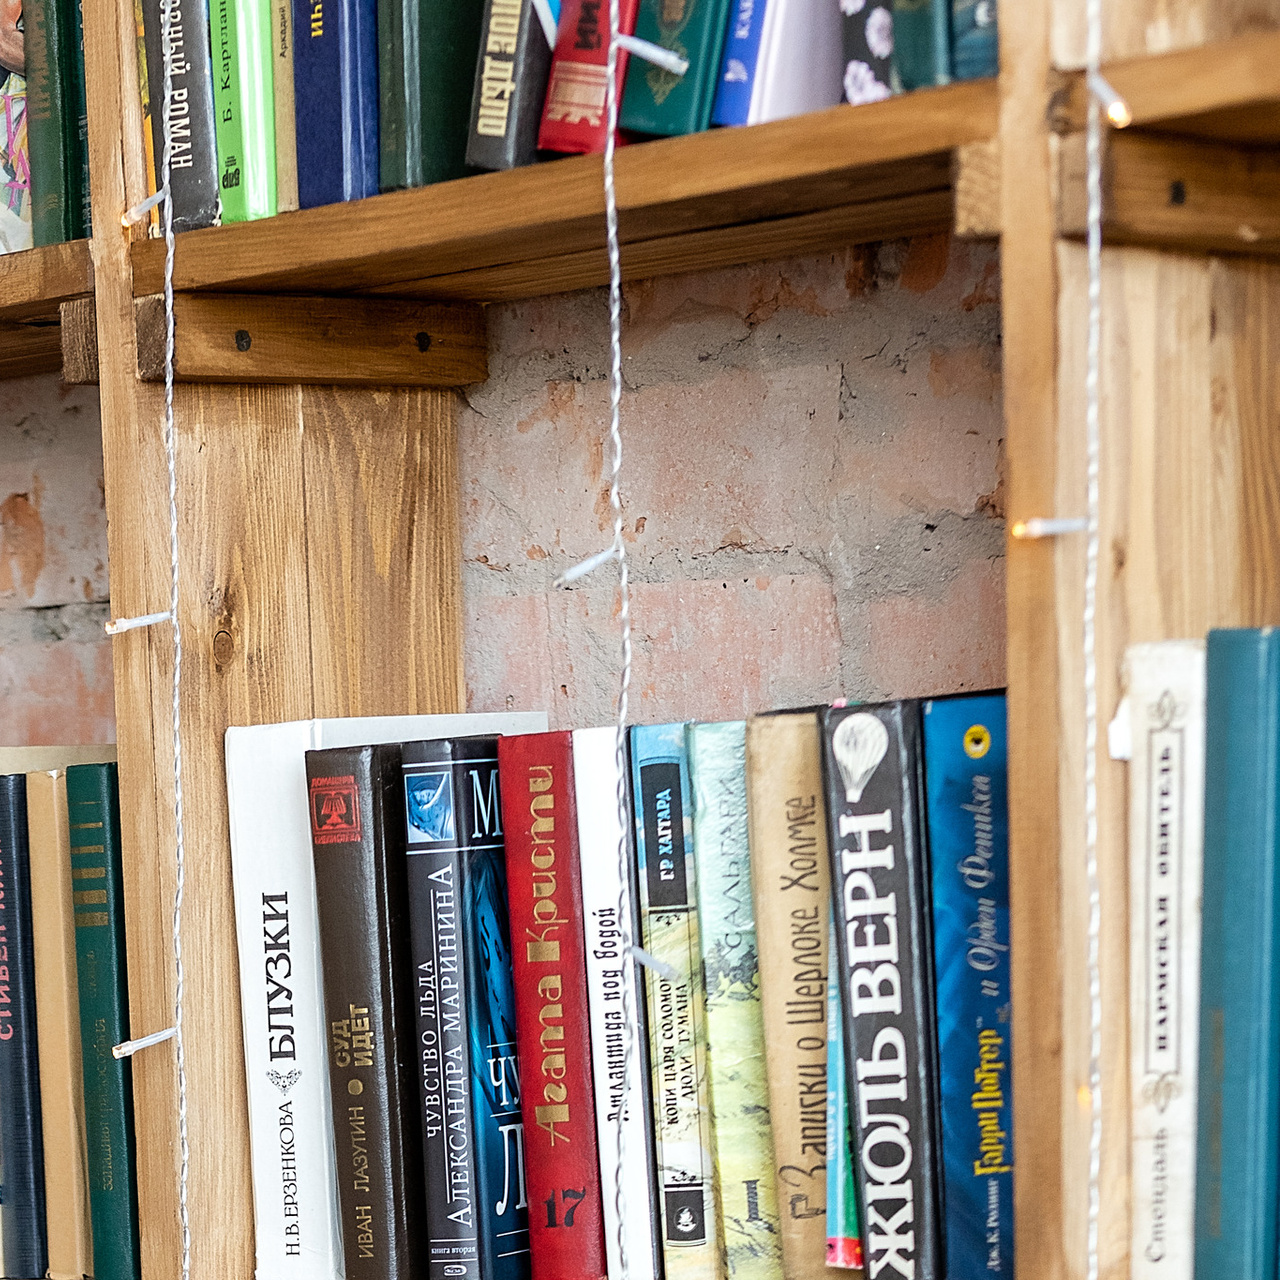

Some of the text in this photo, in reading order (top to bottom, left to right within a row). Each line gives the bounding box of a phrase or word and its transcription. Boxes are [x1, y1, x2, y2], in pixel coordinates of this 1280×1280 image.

[279, 6, 287, 58] Аркадий
[169, 87, 193, 169] РОМАН
[223, 102, 232, 123] Б.
[654, 788, 673, 858] ХАГГАРД
[716, 775, 742, 952] САЛЬГАРИ
[958, 775, 1008, 998] и Орден Феникса
[261, 891, 298, 1061] БЛУЗКИ
[524, 764, 572, 1147] Агата Кристи
[839, 809, 903, 1018] ВЕРН
[1155, 896, 1169, 1054] ПАРМСКАЯ
[331, 1020, 351, 1068] СУД
[349, 1004, 372, 1067] ИДЕТ
[417, 959, 441, 1138] ЧУВСТВО ЛЬДА
[428, 863, 472, 1228] АЛЕКСАНДРА МАРИНИНА
[664, 1042, 676, 1089] ЦАРЯ
[675, 982, 694, 1102] ЛЮДИ ТУМАНА
[972, 1027, 1013, 1178] Гарри Поттер
[666, 1092, 679, 1127] КОПИ
[349, 1105, 372, 1258] ИВАН ЛАЗУТИН
[544, 1186, 587, 1228] 17
[1144, 1126, 1169, 1264] Стендаль
